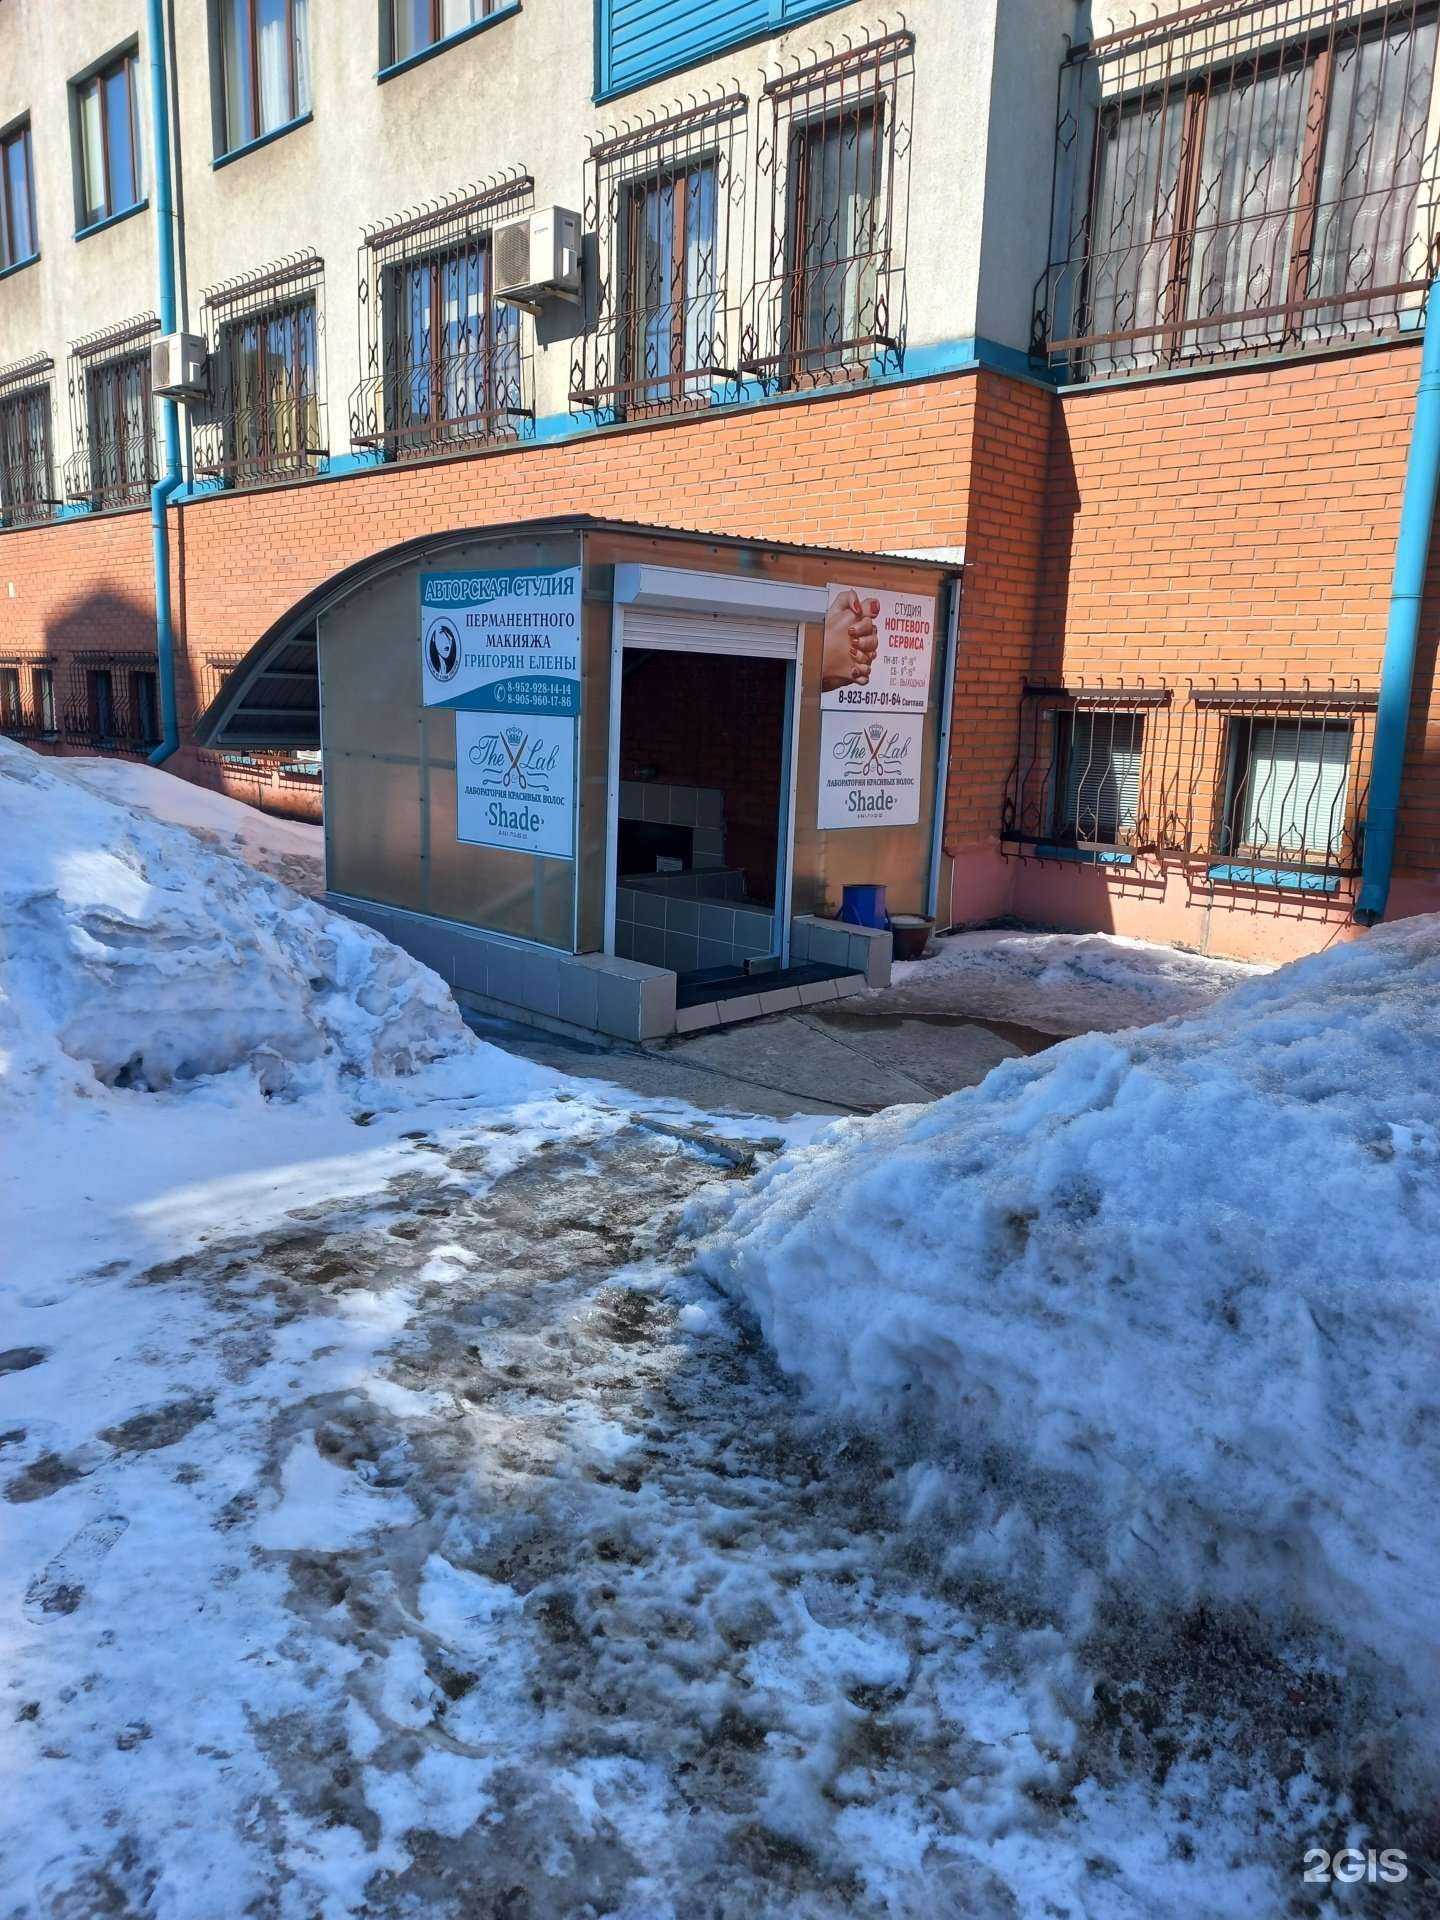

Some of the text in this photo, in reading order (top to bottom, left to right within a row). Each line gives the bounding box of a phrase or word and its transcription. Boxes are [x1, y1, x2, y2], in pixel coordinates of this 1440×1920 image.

[425, 576, 574, 600] АВТОРСКАЯ СТУДИЯ
[894, 602, 922, 617] СТУДИЯ
[466, 612, 575, 627] ПЕРМАНЕНТНОГО
[885, 617, 930, 634] НОГТЕВОГО
[485, 634, 551, 648] МАКИЯЖА
[888, 634, 924, 649] СЕРВИСА
[464, 654, 576, 671] ГРИГОРЯН ЕЛЕНЫ
[507, 682, 571, 695] 8-952-928-14-14
[838, 690, 901, 706] 8-923-617-01-64
[469, 735, 560, 770] The Lab
[833, 731, 911, 760] The Lab
[465, 785, 507, 798] ЛАБОРАТОРИЯ
[542, 794, 565, 806] ВОЛОС
